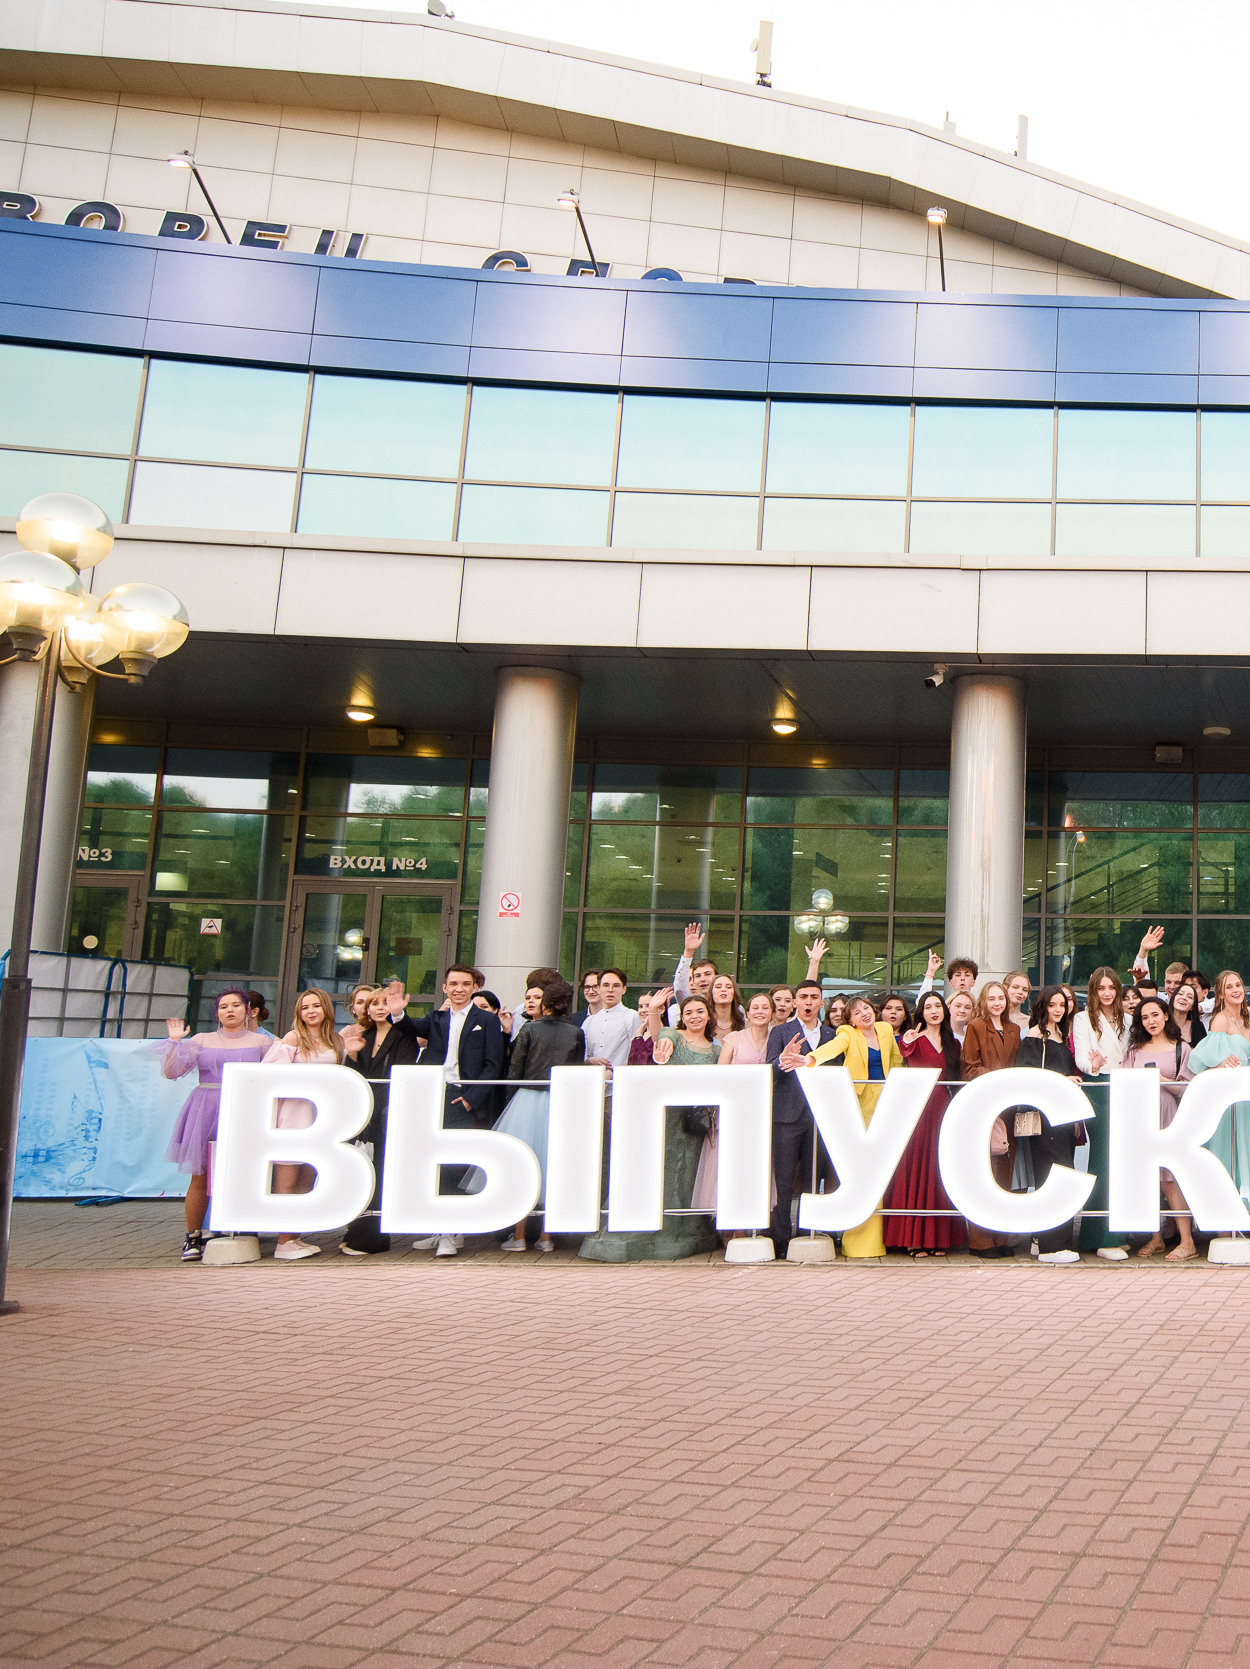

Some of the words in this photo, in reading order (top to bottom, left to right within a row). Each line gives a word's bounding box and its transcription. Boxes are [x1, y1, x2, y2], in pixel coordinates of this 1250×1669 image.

[78, 846, 113, 862] №3
[329, 855, 386, 872] ВХОД
[391, 857, 428, 871] №4
